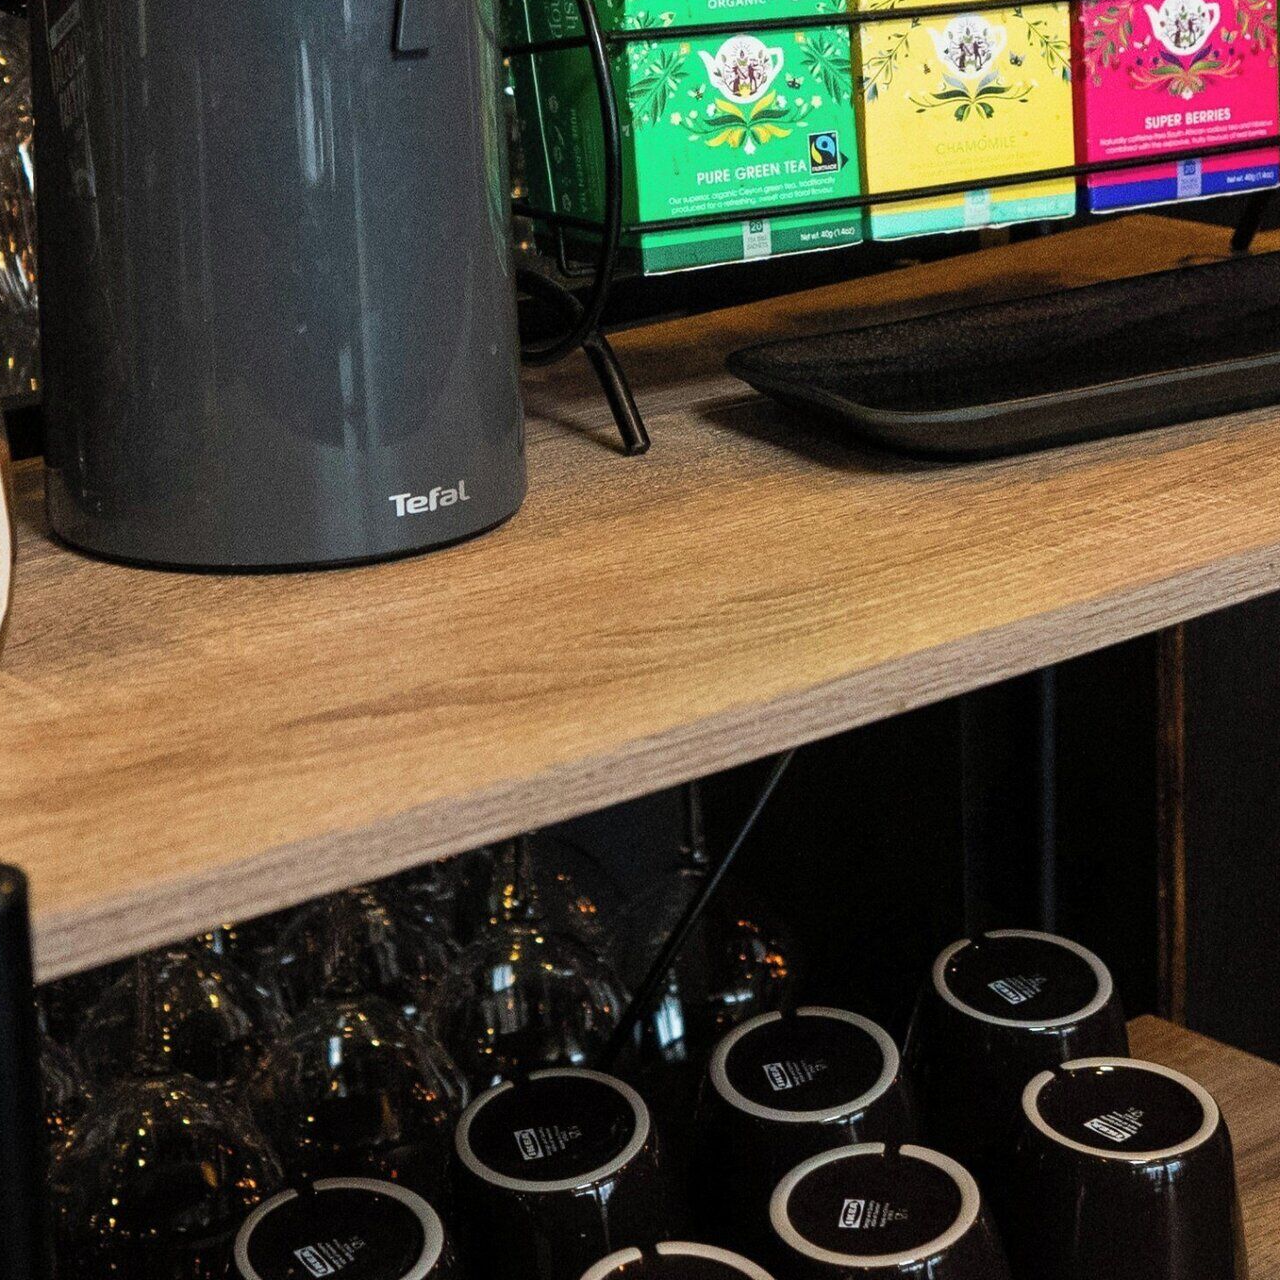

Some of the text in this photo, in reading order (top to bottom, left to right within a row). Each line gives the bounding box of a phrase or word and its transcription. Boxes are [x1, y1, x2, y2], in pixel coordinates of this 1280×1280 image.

[1144, 107, 1231, 130] SUPER BERRIES
[697, 160, 807, 185] PURE GREEN TEA
[750, 221, 762, 232] 20
[389, 480, 471, 517] Tefal
